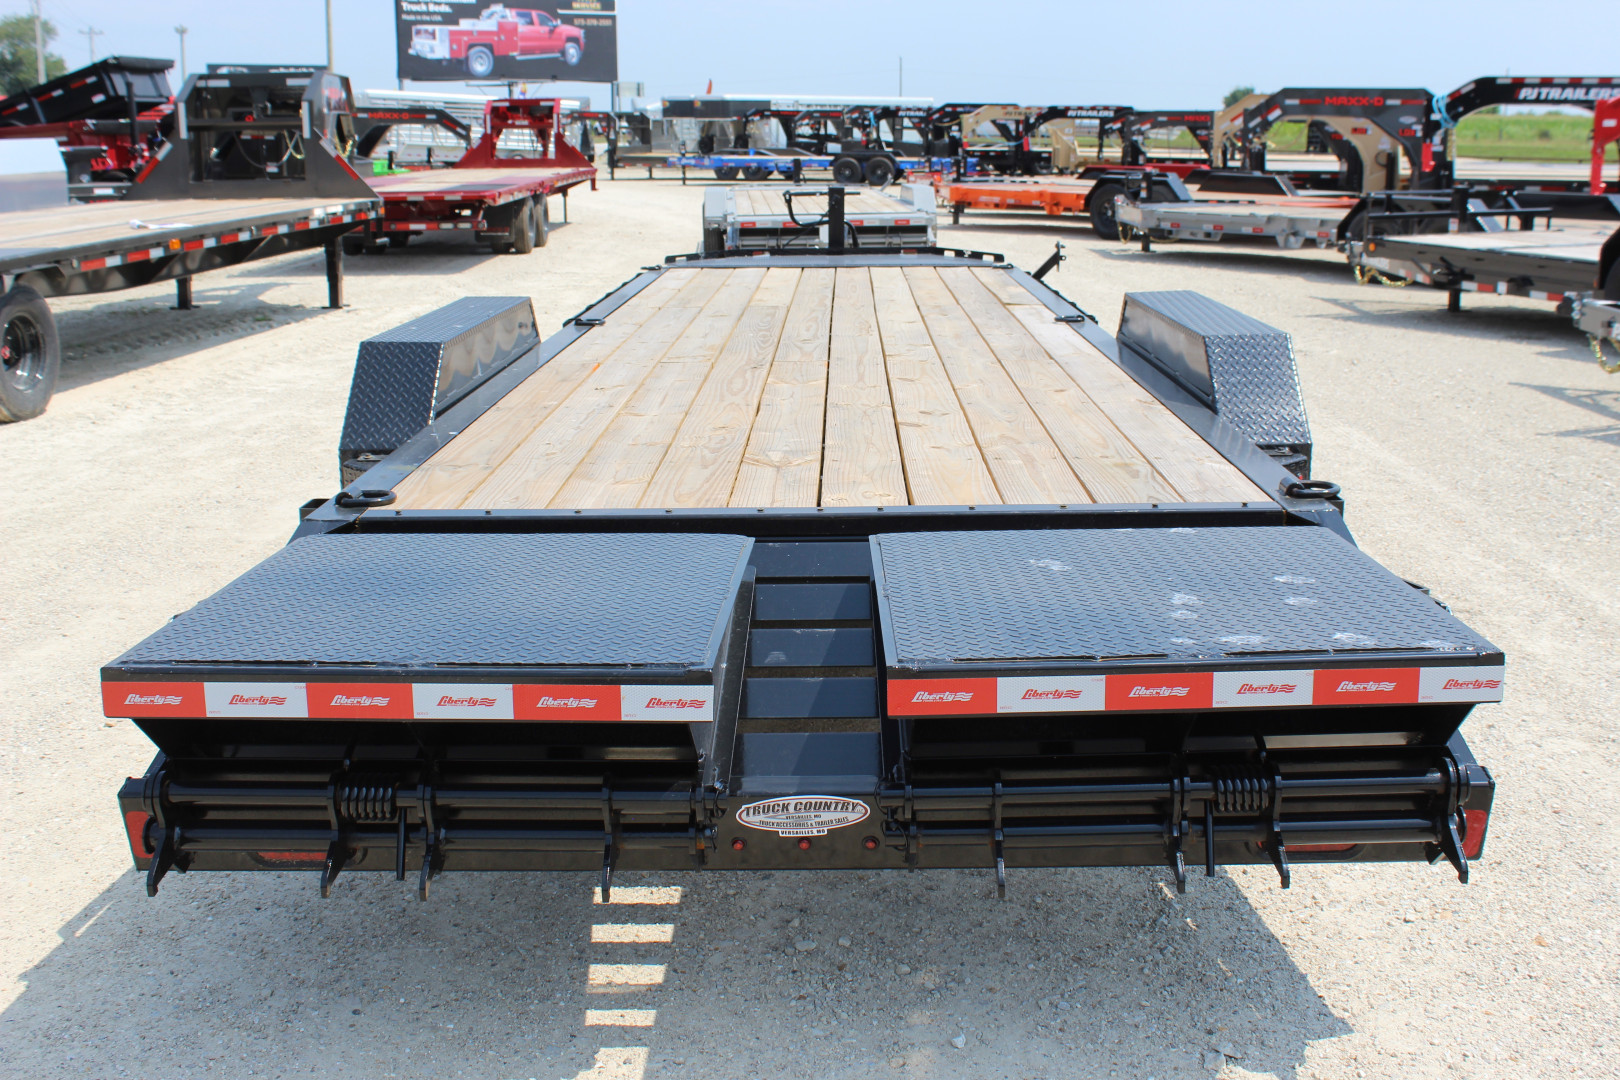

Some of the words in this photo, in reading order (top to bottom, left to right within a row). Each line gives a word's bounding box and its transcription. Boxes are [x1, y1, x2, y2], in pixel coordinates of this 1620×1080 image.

[400, 1, 427, 12] Truck
[1325, 96, 1384, 106] MAXX-D
[1236, 683, 1280, 694] Liberty
[1336, 681, 1380, 692] Liberty
[1442, 678, 1485, 690] Liberty
[911, 691, 956, 702] Liberty
[1020, 688, 1065, 700] Liberty
[1128, 686, 1173, 697] Liberty
[124, 693, 166, 705] Liberty
[228, 694, 270, 706] Liberty
[330, 694, 373, 706] Liberty
[436, 695, 479, 707] Liberty
[536, 696, 582, 708] Liberty
[645, 697, 690, 709] Liberty
[745, 802, 791, 817] TRUCK
[794, 800, 859, 812] COUNTRY
[814, 818, 833, 826] TRAILER
[834, 815, 849, 824] SALES
